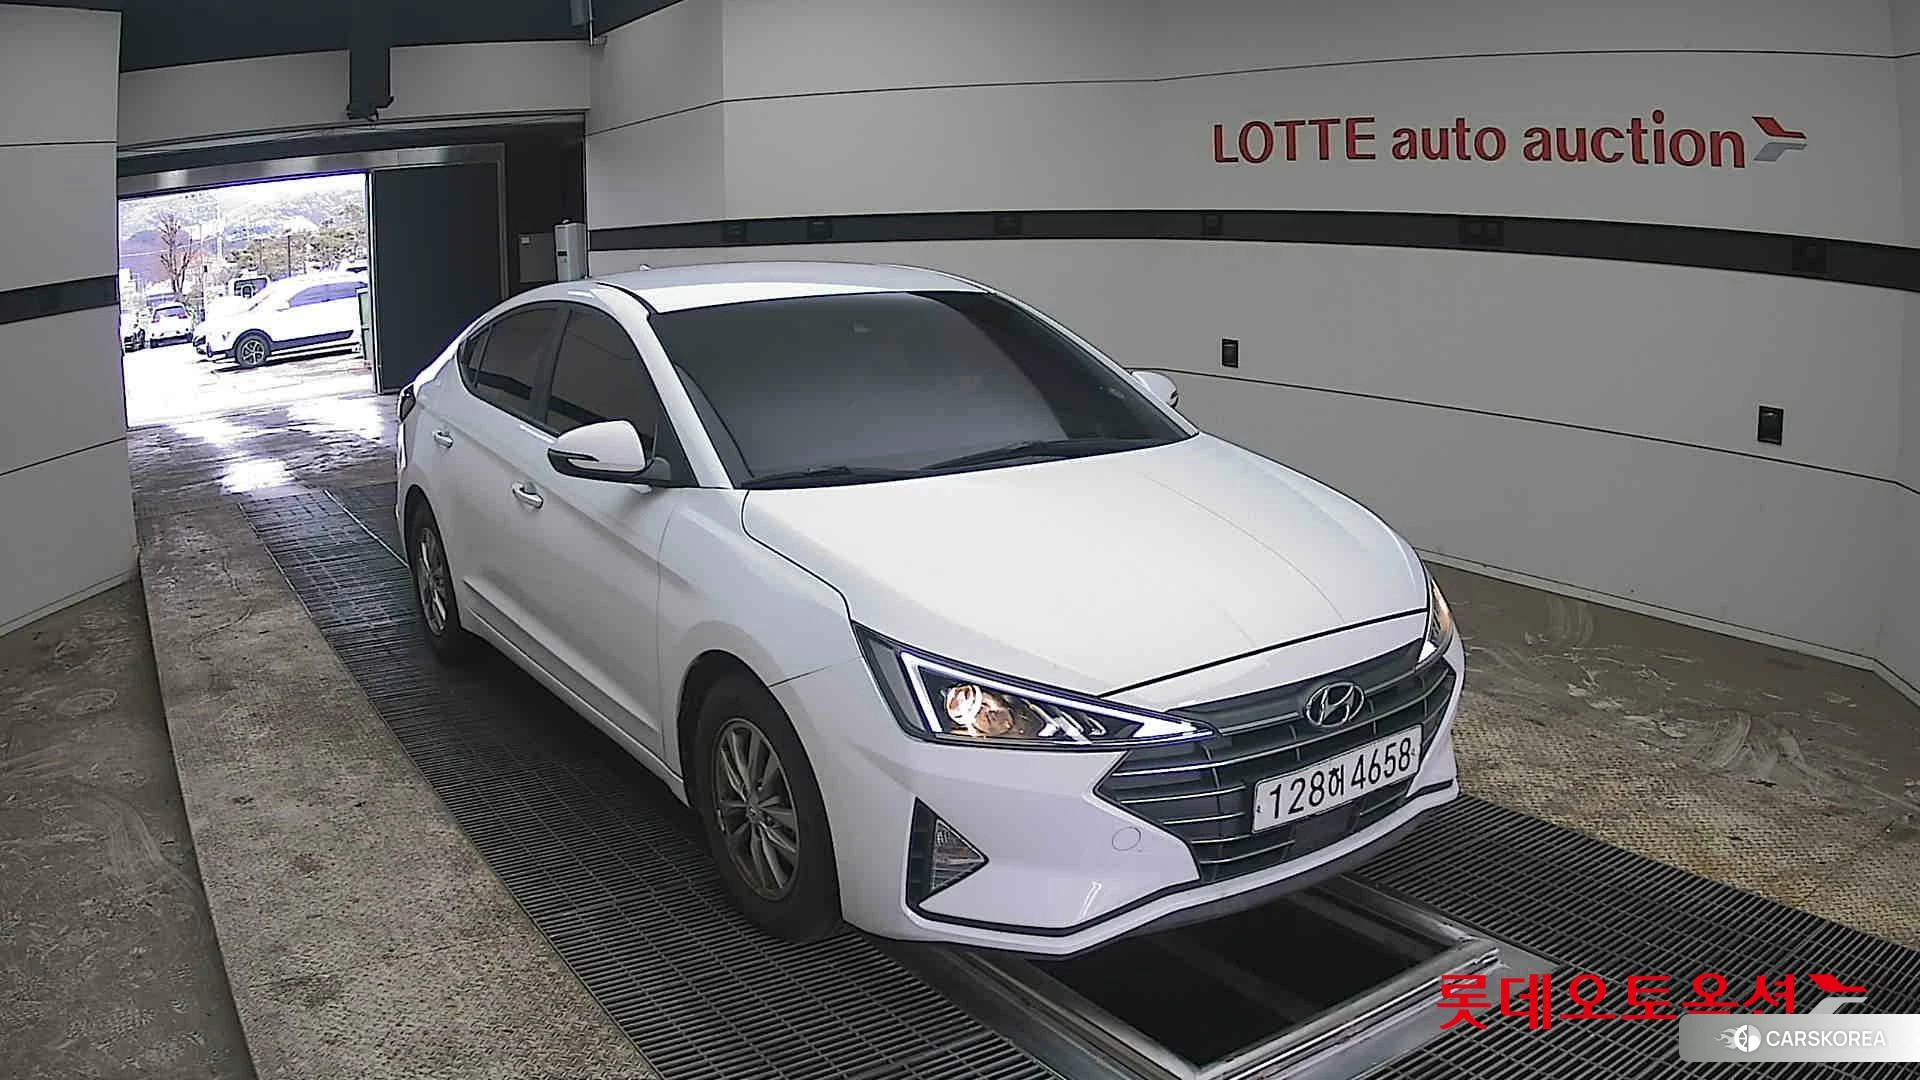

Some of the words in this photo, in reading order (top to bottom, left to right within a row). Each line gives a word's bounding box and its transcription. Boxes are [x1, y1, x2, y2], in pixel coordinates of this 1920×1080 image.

[1213, 117, 1377, 163] LOTTE
[1392, 118, 1507, 162] auto
[1523, 110, 1745, 169] auction
[1270, 765, 1344, 819] 128허
[1351, 738, 1411, 789] 4658
